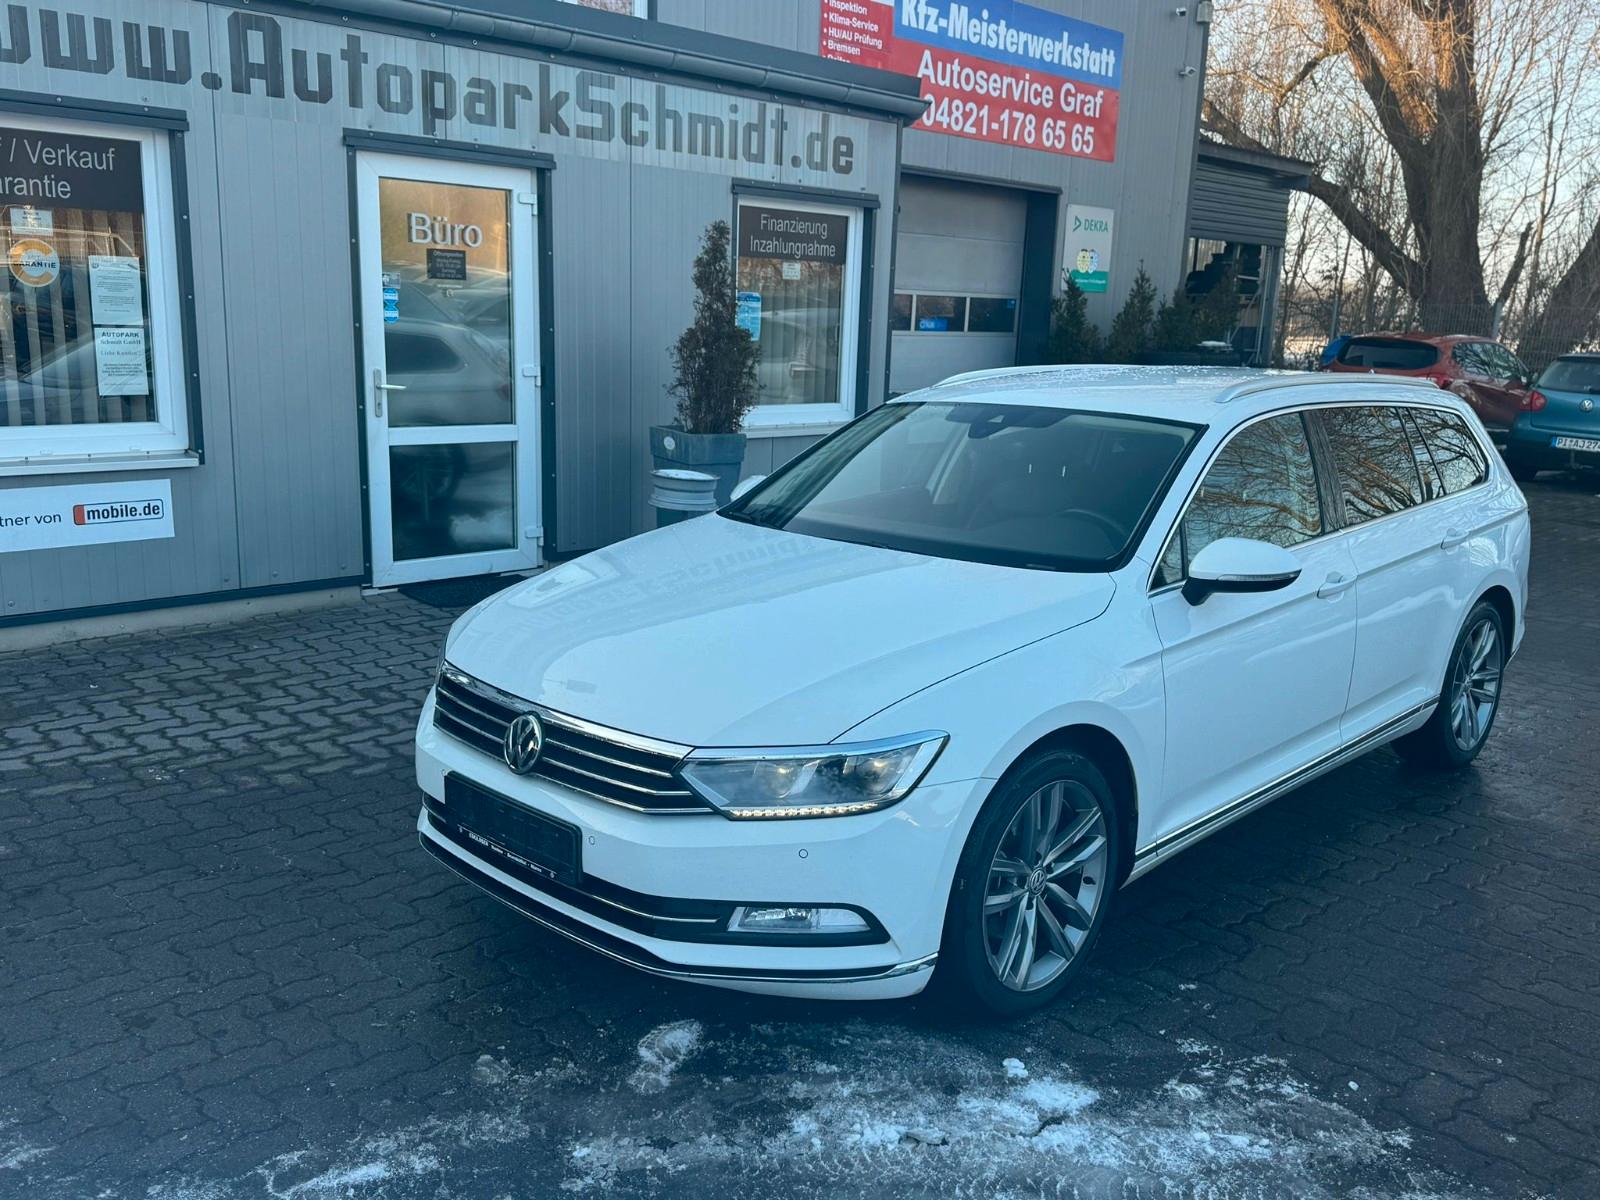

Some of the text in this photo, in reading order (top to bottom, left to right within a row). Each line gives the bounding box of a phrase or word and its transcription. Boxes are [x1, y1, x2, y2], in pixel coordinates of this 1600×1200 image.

[829, 0, 868, 15] Inspektion
[829, 12, 879, 33] Klima-Service
[827, 39, 861, 56] Bremsen
[828, 26, 883, 50] HU/AU Prüfung
[901, 0, 1116, 78] Kfz-Meisterwerkstatt
[917, 49, 1104, 119] Autoservice Graf
[921, 93, 1094, 155] 04821-178 65 65
[24, 140, 115, 171] Verkauf
[409, 212, 483, 248] Büro
[760, 213, 828, 239] Finanzierung
[1083, 218, 1109, 233] DEKRA
[750, 234, 836, 259] Inzahlungnahme
[34, 512, 62, 525] von
[87, 503, 161, 520] mobile.de
